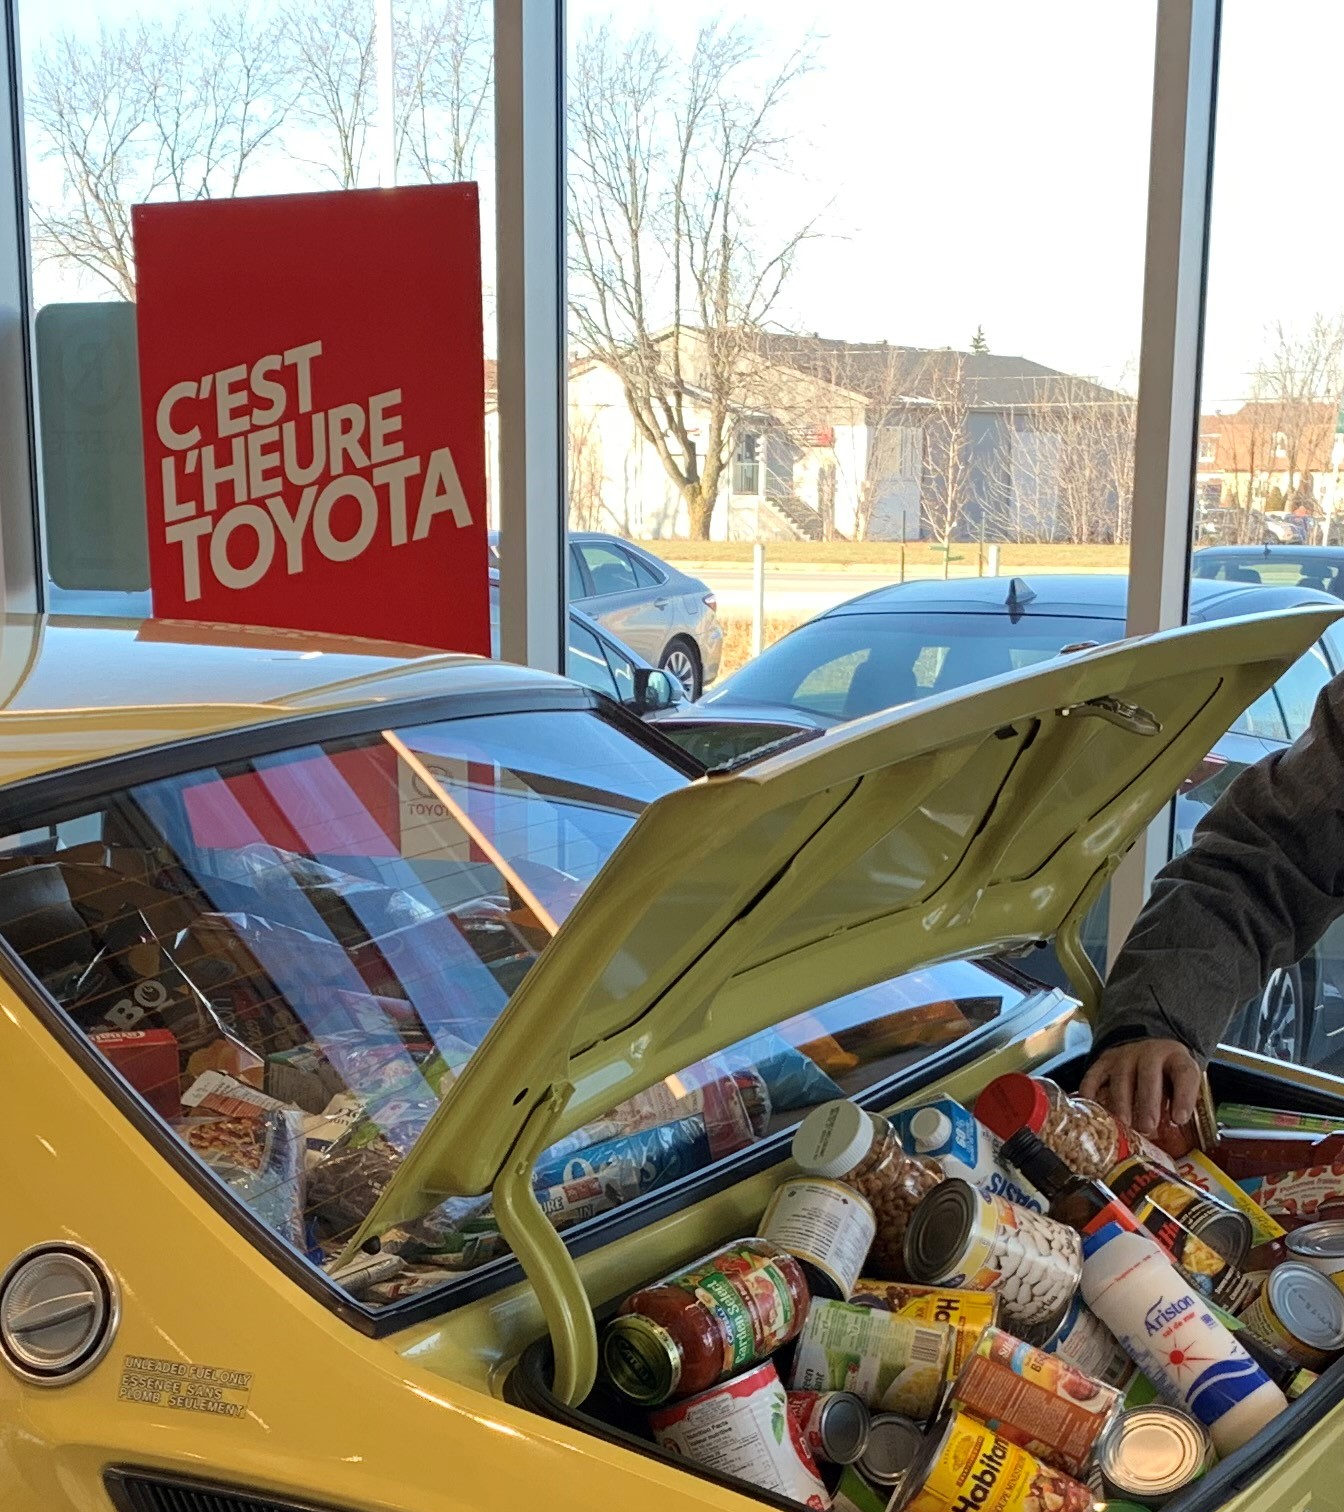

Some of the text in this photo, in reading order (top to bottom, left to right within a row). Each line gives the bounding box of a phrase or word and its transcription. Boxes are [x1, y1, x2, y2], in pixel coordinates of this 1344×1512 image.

[156, 340, 323, 451] C'EST
[161, 388, 404, 523] L'HEURE
[164, 447, 474, 602] TOYOTA
[710, 1279, 741, 1315] Select
[1144, 1295, 1195, 1338] Ariston
[735, 1314, 753, 1365] Garden
[121, 1374, 223, 1401] ESSENCE SANS
[124, 1357, 253, 1386] UNLEADED FUEL ONLY
[118, 1387, 244, 1417] PLOMB SEULEMENT
